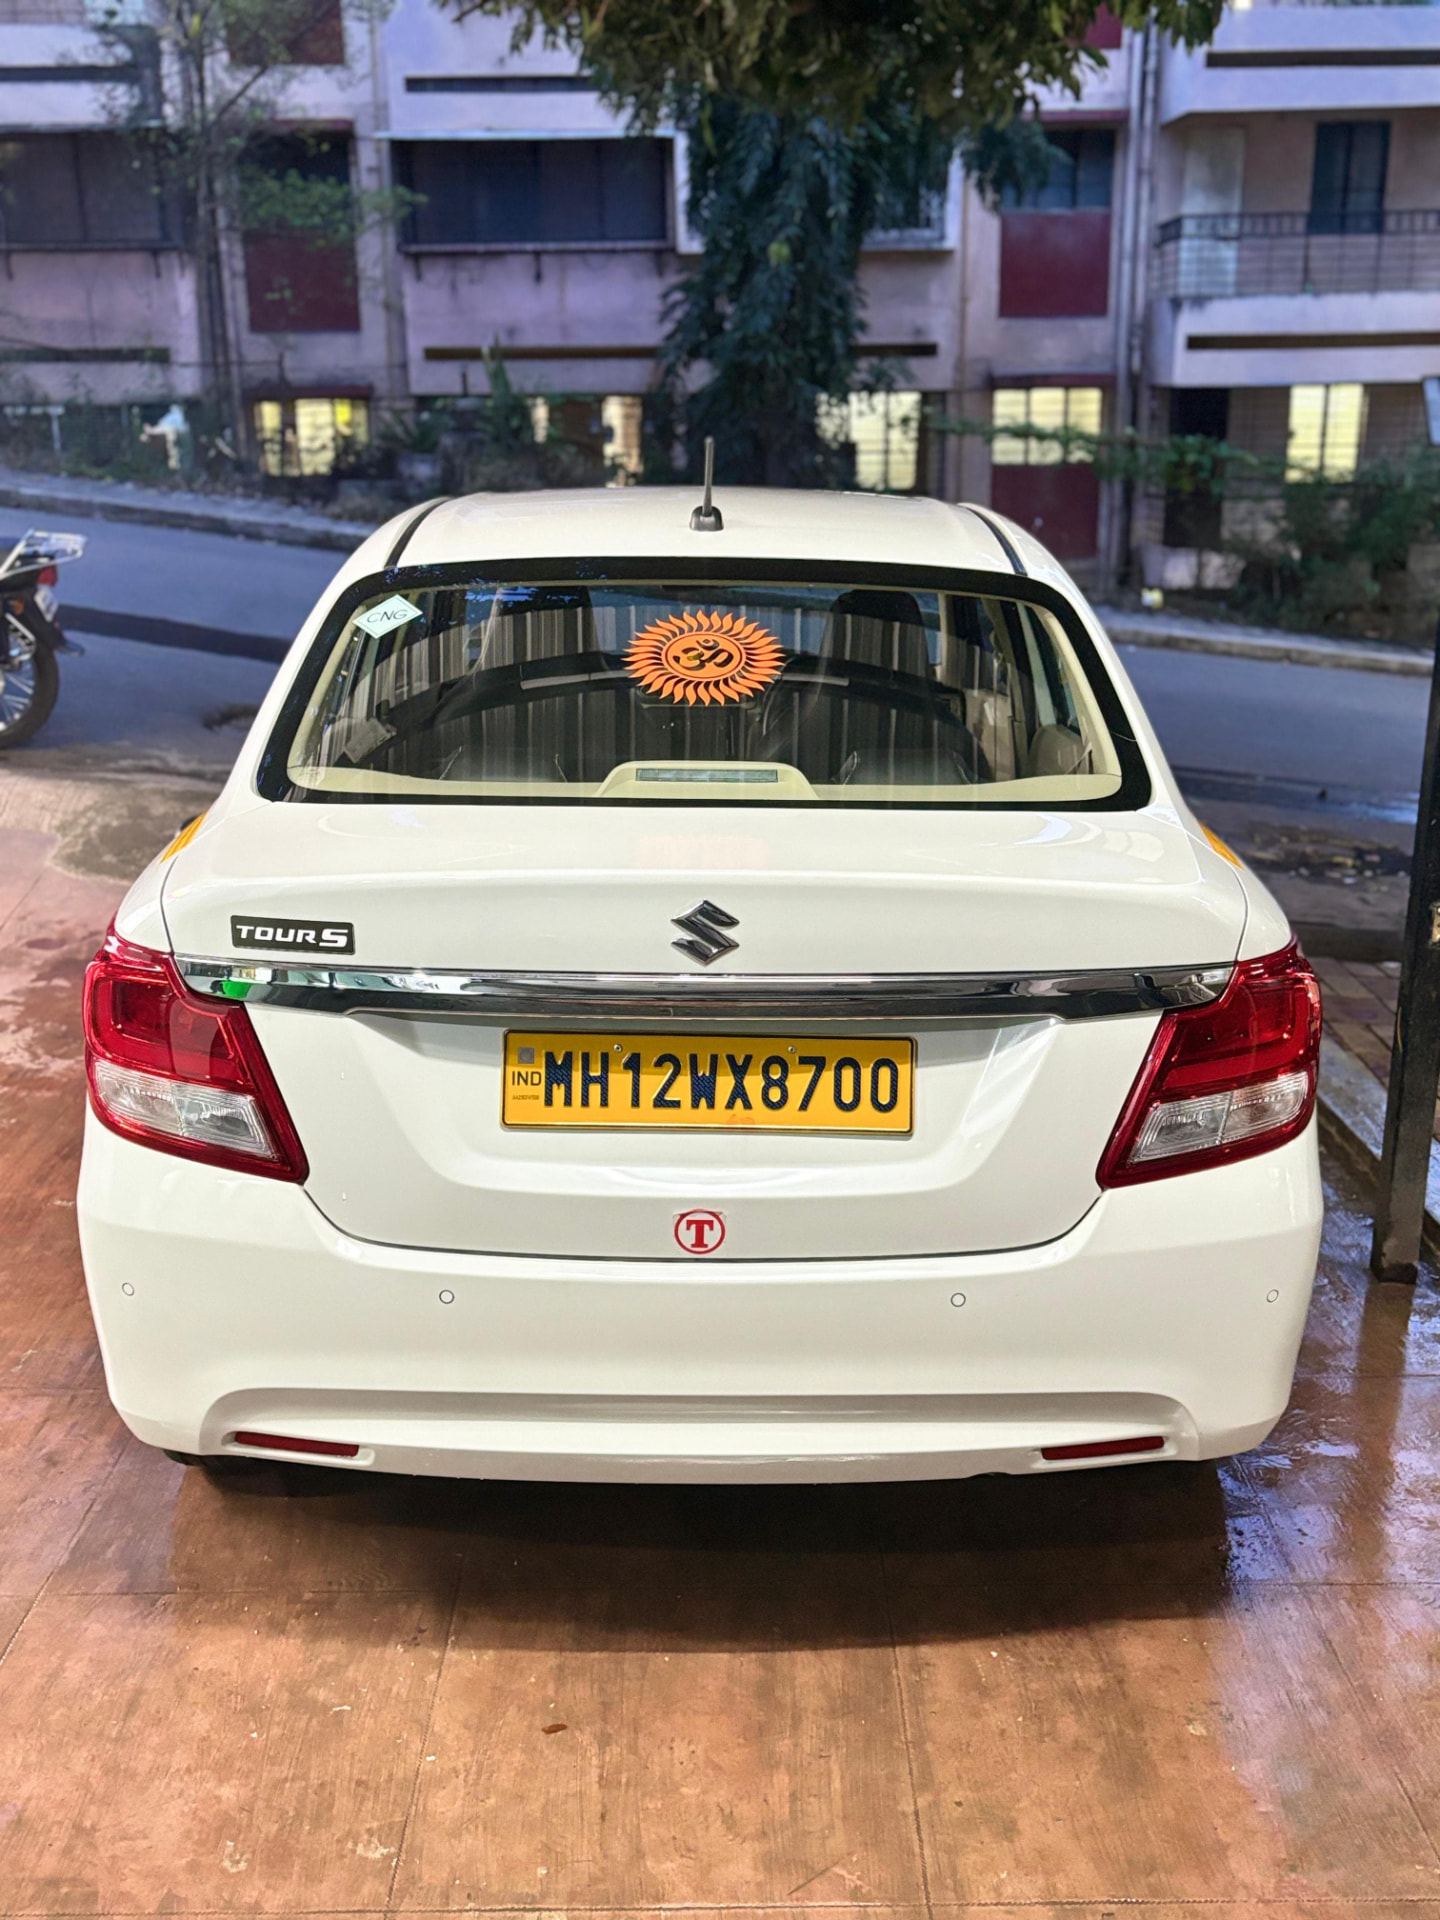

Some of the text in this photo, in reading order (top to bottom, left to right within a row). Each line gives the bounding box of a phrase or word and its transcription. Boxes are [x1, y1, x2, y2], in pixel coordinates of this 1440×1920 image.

[367, 609, 408, 623] CNG
[512, 1070, 542, 1086] IND
[544, 1051, 899, 1113] MH12WX8700
[686, 1219, 714, 1248] T
